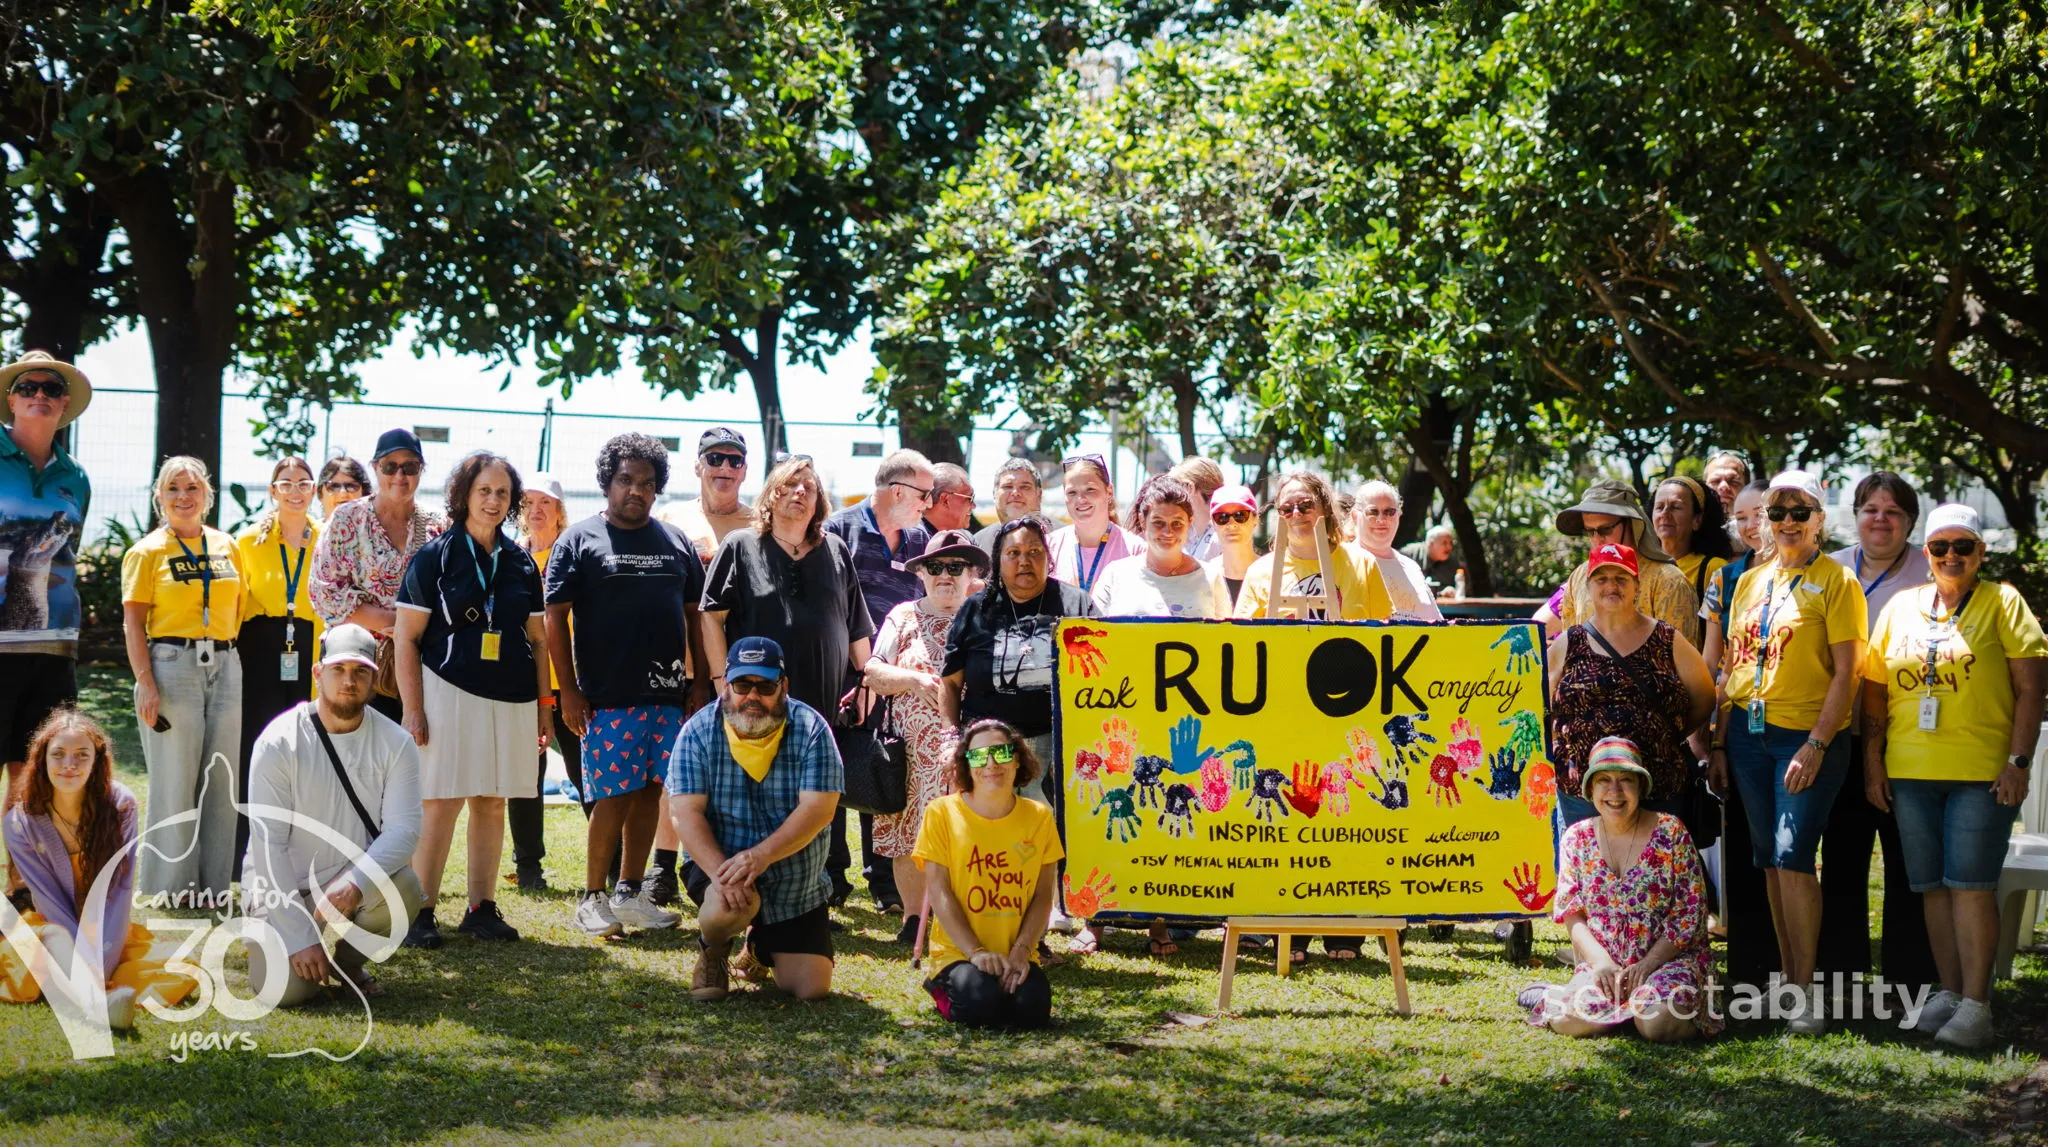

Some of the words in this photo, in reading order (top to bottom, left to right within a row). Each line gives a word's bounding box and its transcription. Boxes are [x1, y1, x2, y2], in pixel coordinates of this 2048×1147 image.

[1074, 676, 1137, 709] ask
[1427, 668, 1523, 715] anyday
[1208, 821, 1290, 843] INSPIRE
[1297, 826, 1410, 844] CLUBHOUSE
[1424, 825, 1501, 844] welcomes
[1139, 854, 1169, 867] TSV
[1174, 855, 1224, 869] MENTAL
[1227, 856, 1279, 869] HEALTH
[1290, 856, 1332, 869] HUB
[1401, 853, 1476, 869] INGHAM
[1143, 881, 1236, 899] BURDEKIN
[1292, 880, 1392, 900] CHARTERS
[1400, 878, 1485, 896] TOWERS
